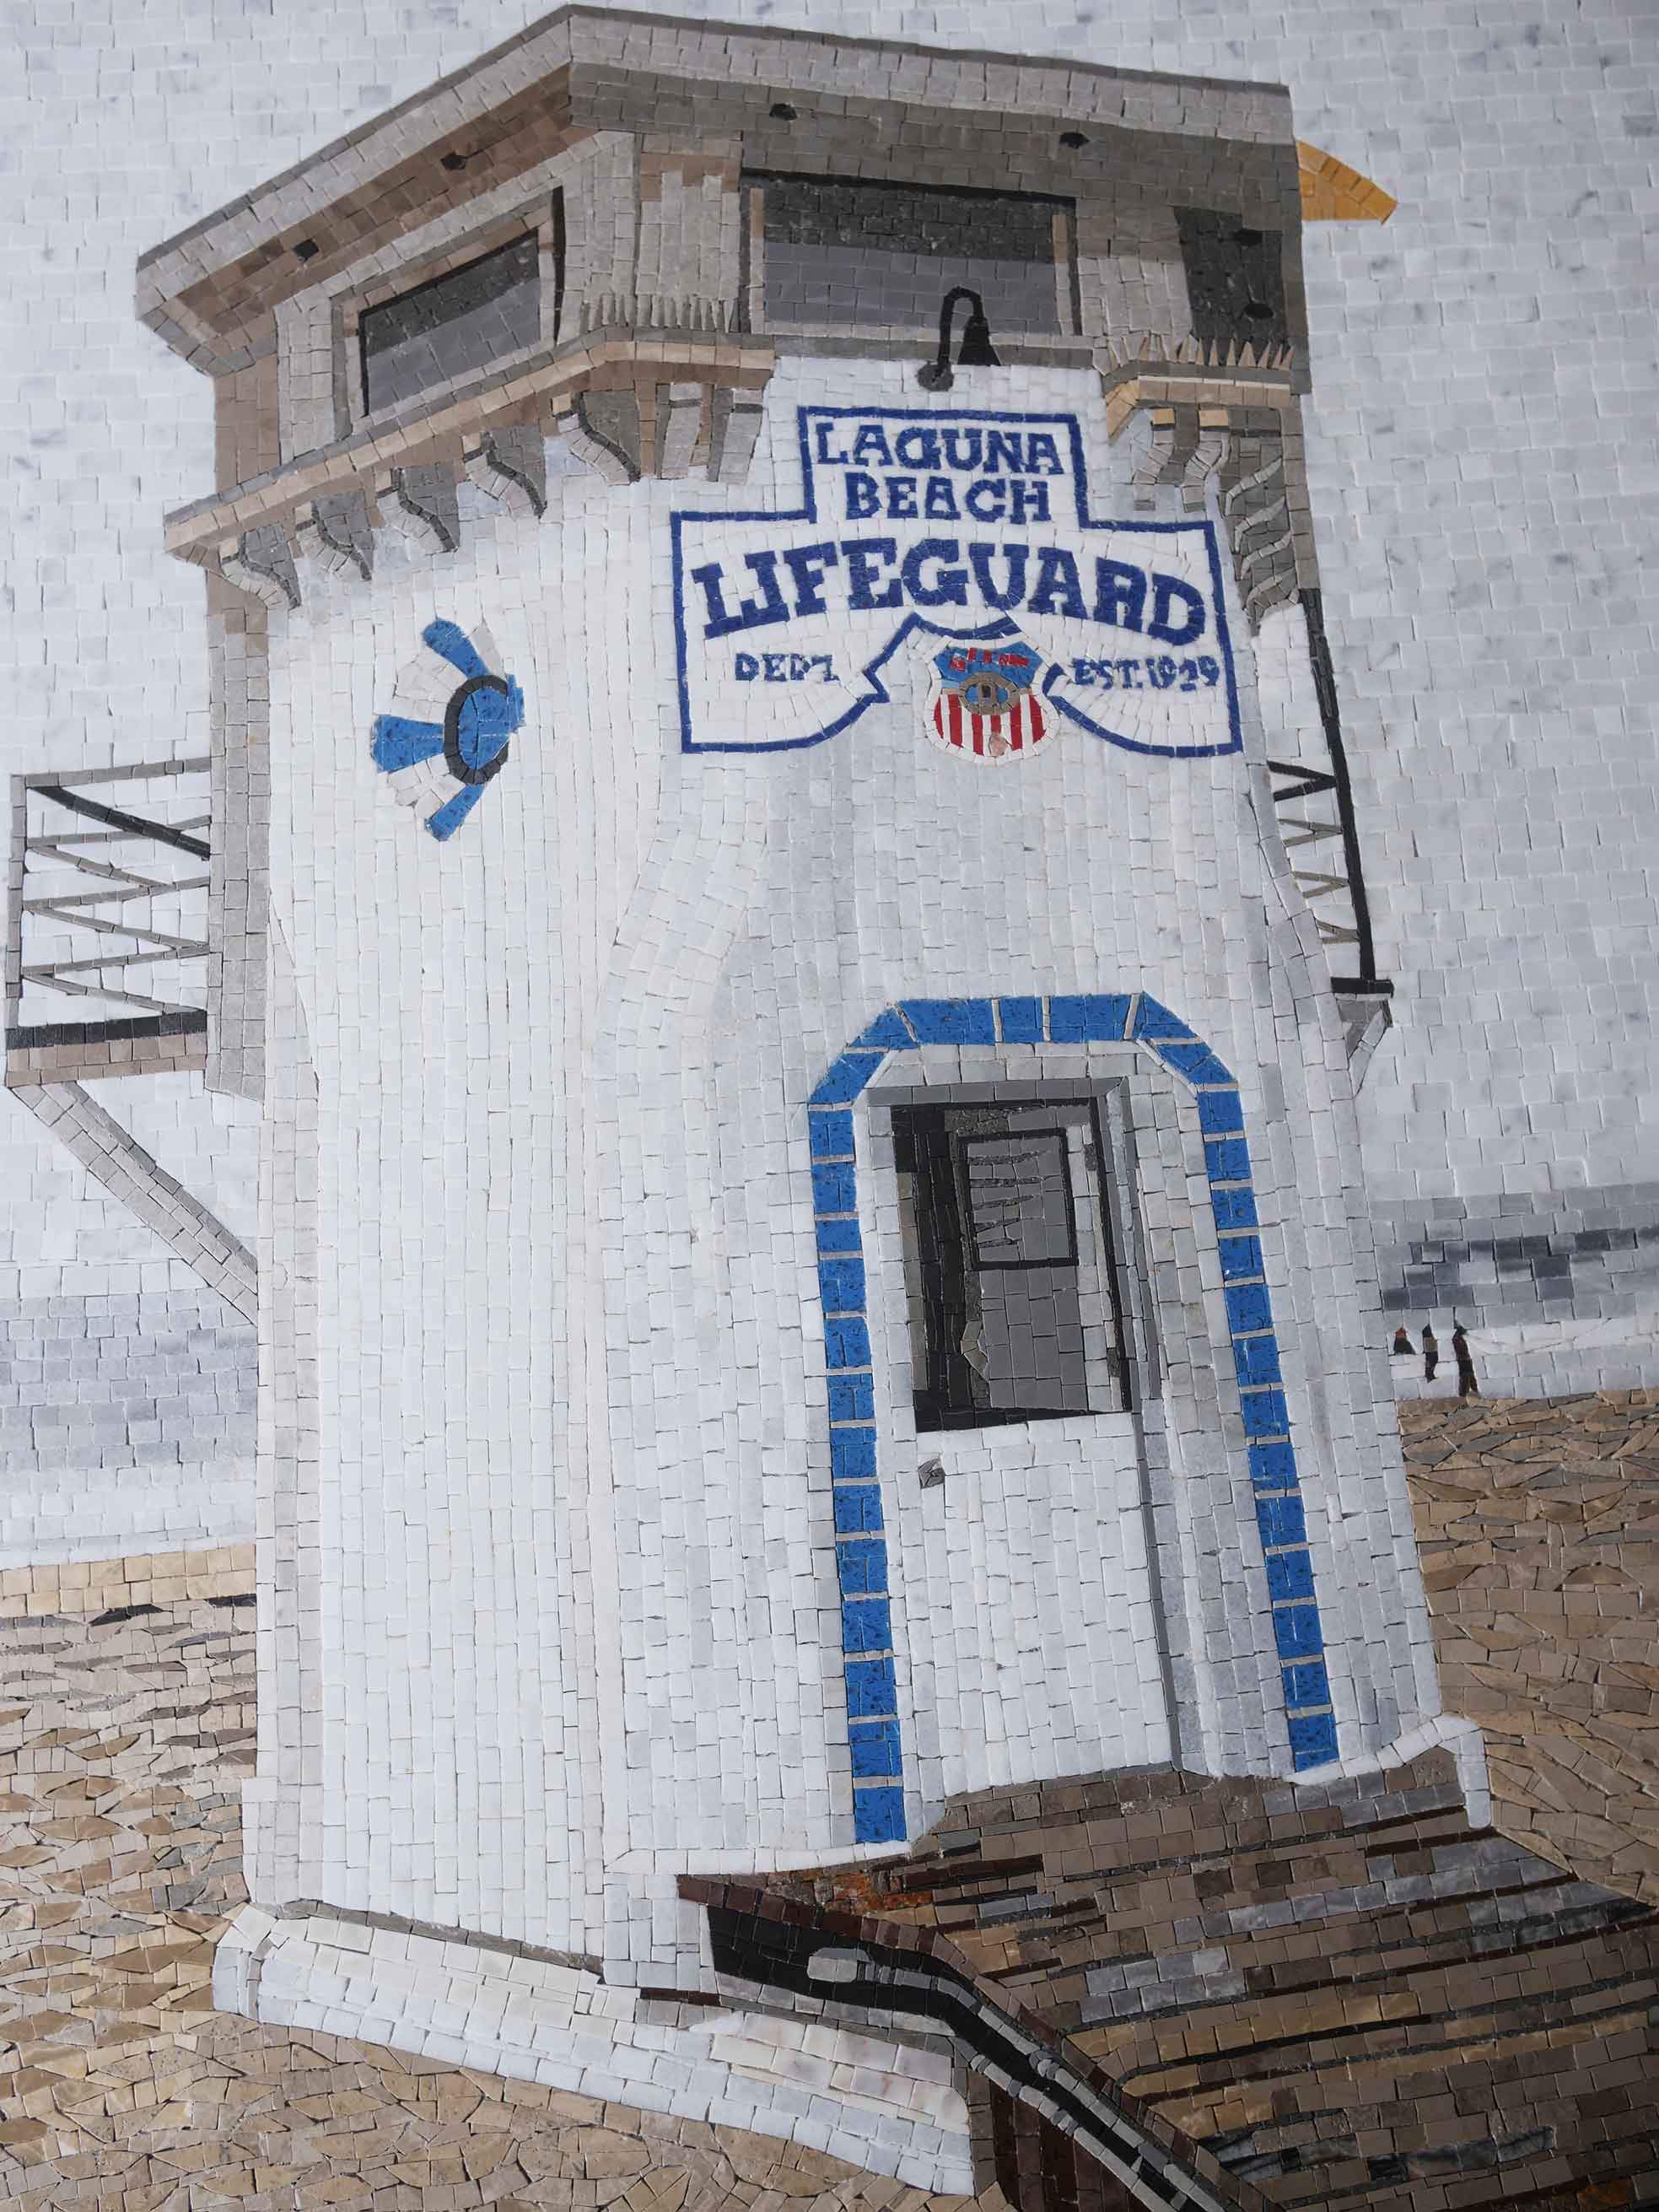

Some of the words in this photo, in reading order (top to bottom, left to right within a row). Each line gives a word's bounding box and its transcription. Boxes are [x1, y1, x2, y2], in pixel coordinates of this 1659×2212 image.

[816, 422, 1064, 475] LAGUNA
[844, 472, 1052, 525] BEACH
[691, 537, 1207, 646] LIFEGUARD
